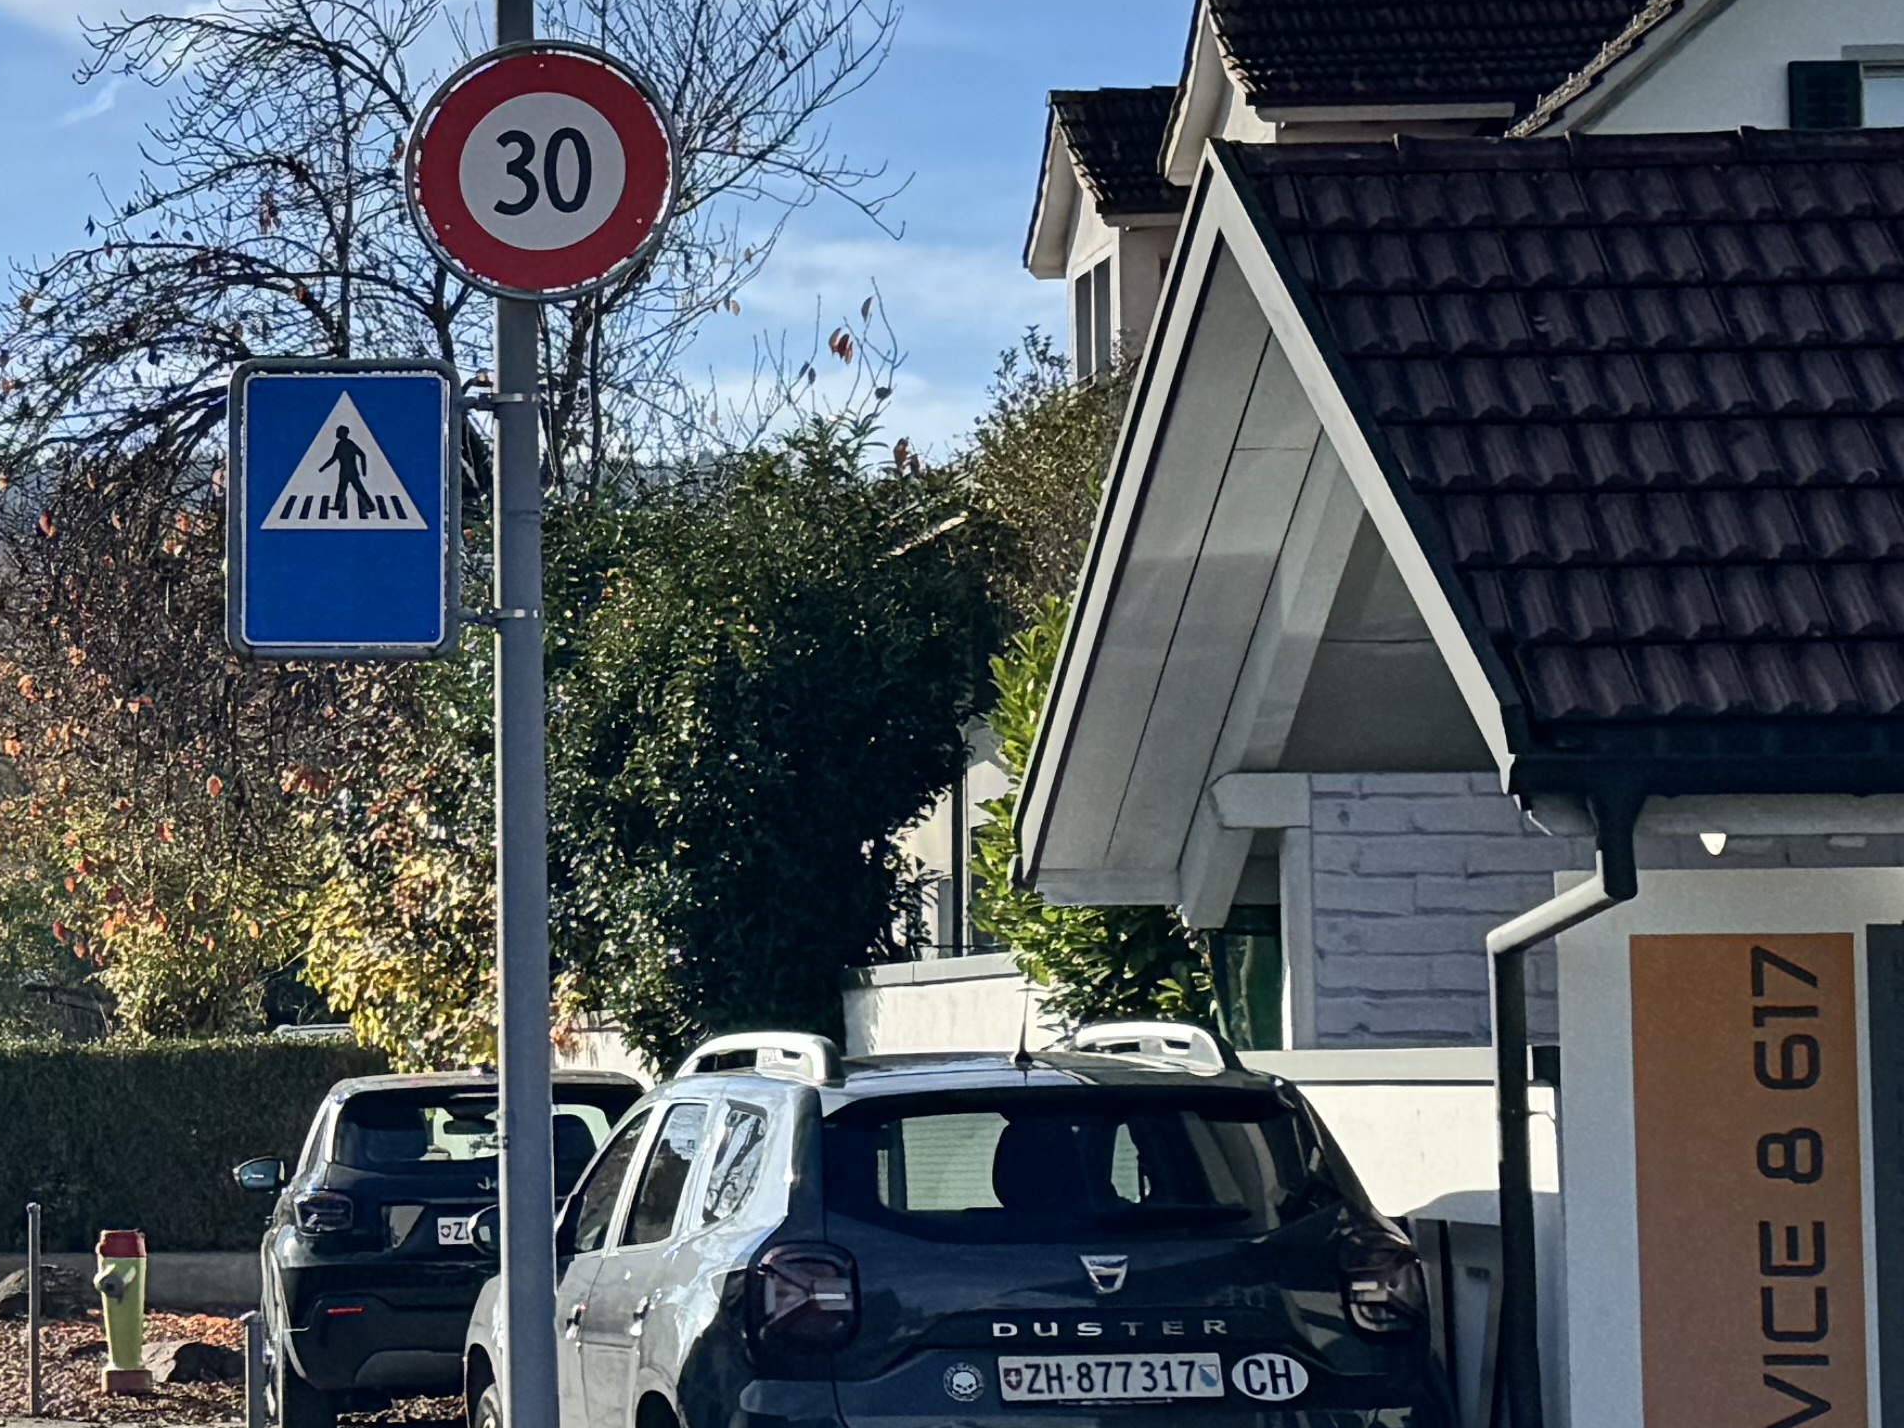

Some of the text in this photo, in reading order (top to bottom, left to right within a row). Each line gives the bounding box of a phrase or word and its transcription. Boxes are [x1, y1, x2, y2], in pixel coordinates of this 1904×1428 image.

[493, 127, 592, 216] 30
[1751, 945, 1821, 1090] 617
[1756, 1127, 1823, 1184] 8
[992, 1319, 1228, 1337] DUSTER
[1242, 1358, 1292, 1395] CH
